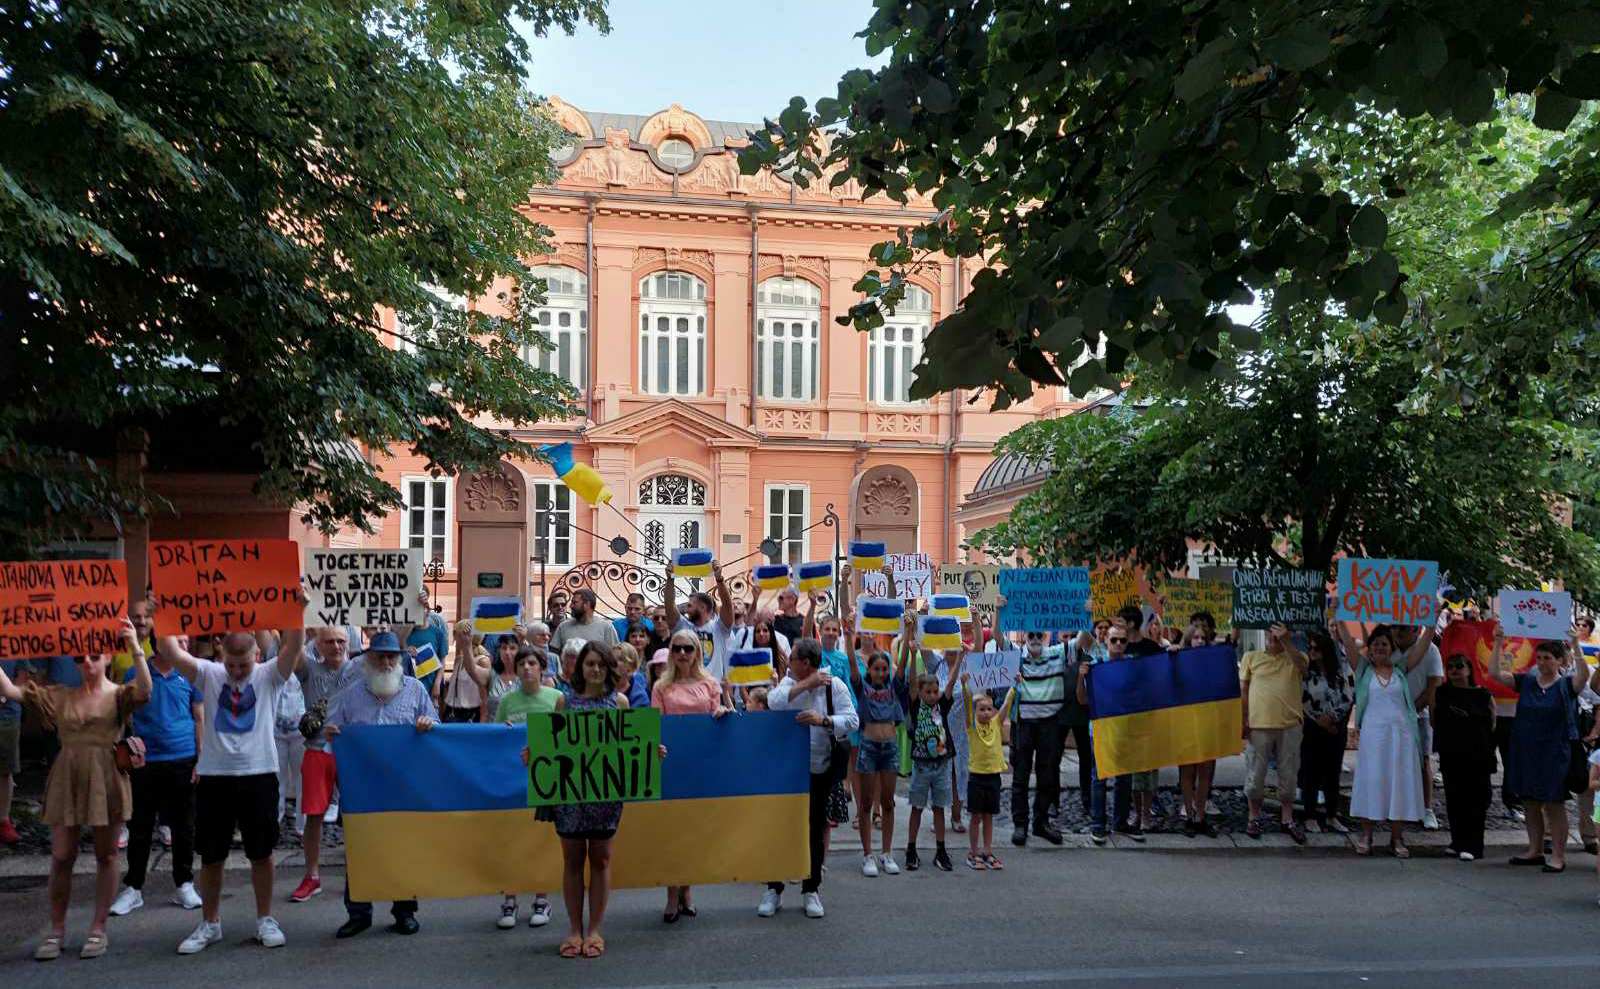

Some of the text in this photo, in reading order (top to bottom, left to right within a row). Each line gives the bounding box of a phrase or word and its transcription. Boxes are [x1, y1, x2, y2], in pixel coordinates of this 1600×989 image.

[314, 553, 408, 571] TOGETHER
[61, 563, 118, 587] VLADA
[307, 573, 409, 590] WE STAND
[944, 572, 962, 585] PUT
[1067, 569, 1088, 583] VID
[866, 574, 930, 598] NO CRY
[324, 591, 404, 608] DIVIDED
[1290, 590, 1318, 604] TEST
[68, 600, 125, 621] SASTAV
[318, 608, 416, 626] WE FALL
[1012, 602, 1082, 615] SLOBODE
[180, 611, 256, 633] PUTU
[981, 653, 1004, 668] NO
[972, 667, 1010, 688] WAR
